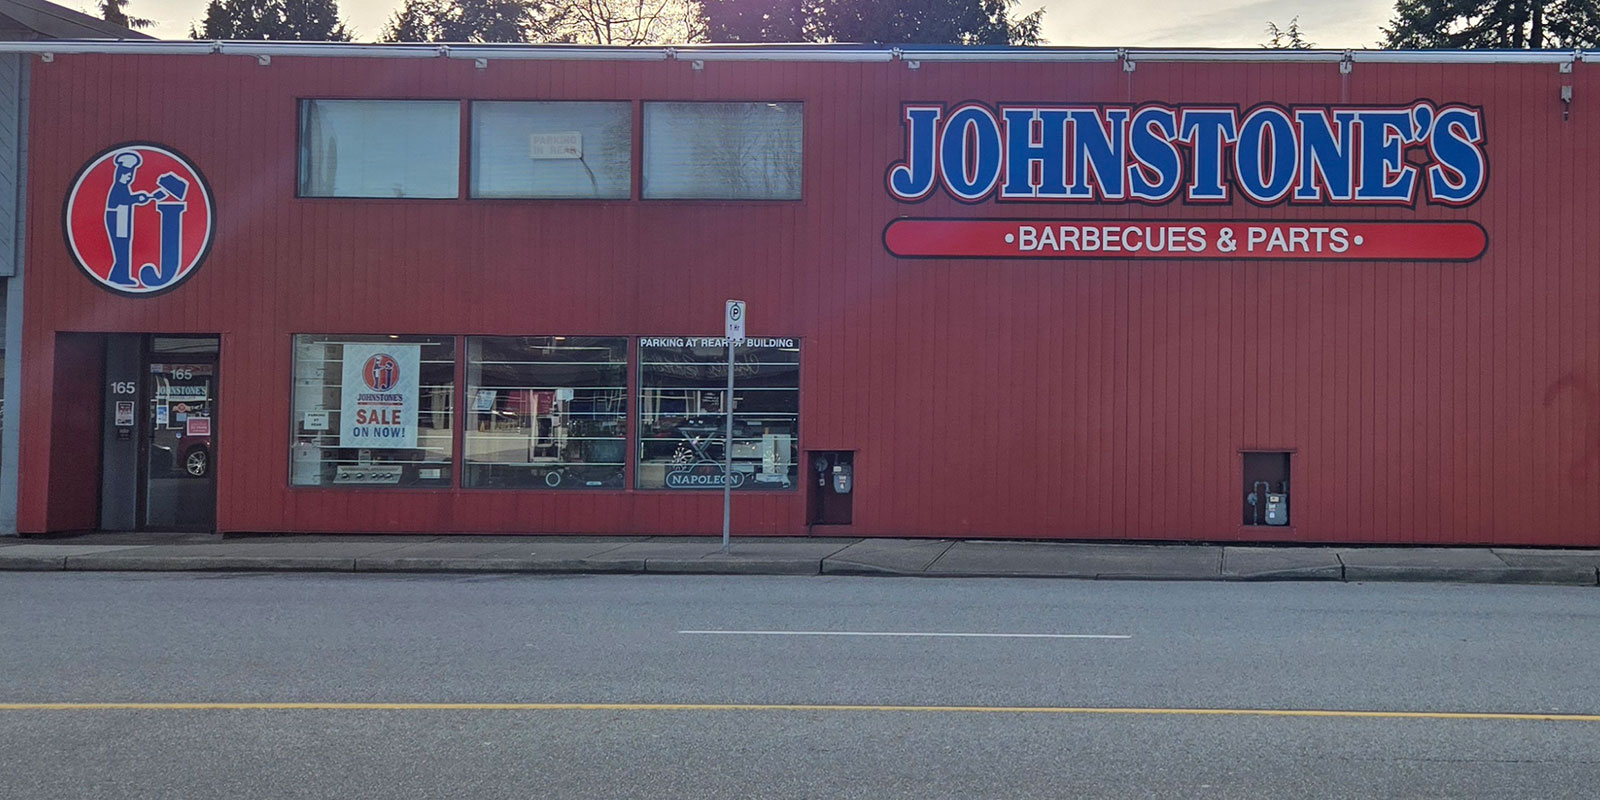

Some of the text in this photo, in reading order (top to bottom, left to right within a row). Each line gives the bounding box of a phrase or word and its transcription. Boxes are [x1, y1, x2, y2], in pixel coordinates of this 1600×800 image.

[533, 135, 577, 145] PARKING
[889, 103, 1486, 203] JOHNSTONE'S
[1019, 226, 1349, 253] BARBECUES & PARTS
[640, 338, 683, 348] PARKING
[684, 338, 697, 348] AT
[701, 338, 729, 348] REAR
[747, 339, 793, 348] BUILDING
[170, 369, 192, 380] 165
[111, 382, 136, 394] 165
[356, 409, 402, 425] SALE
[353, 427, 405, 438] ON NOW!
